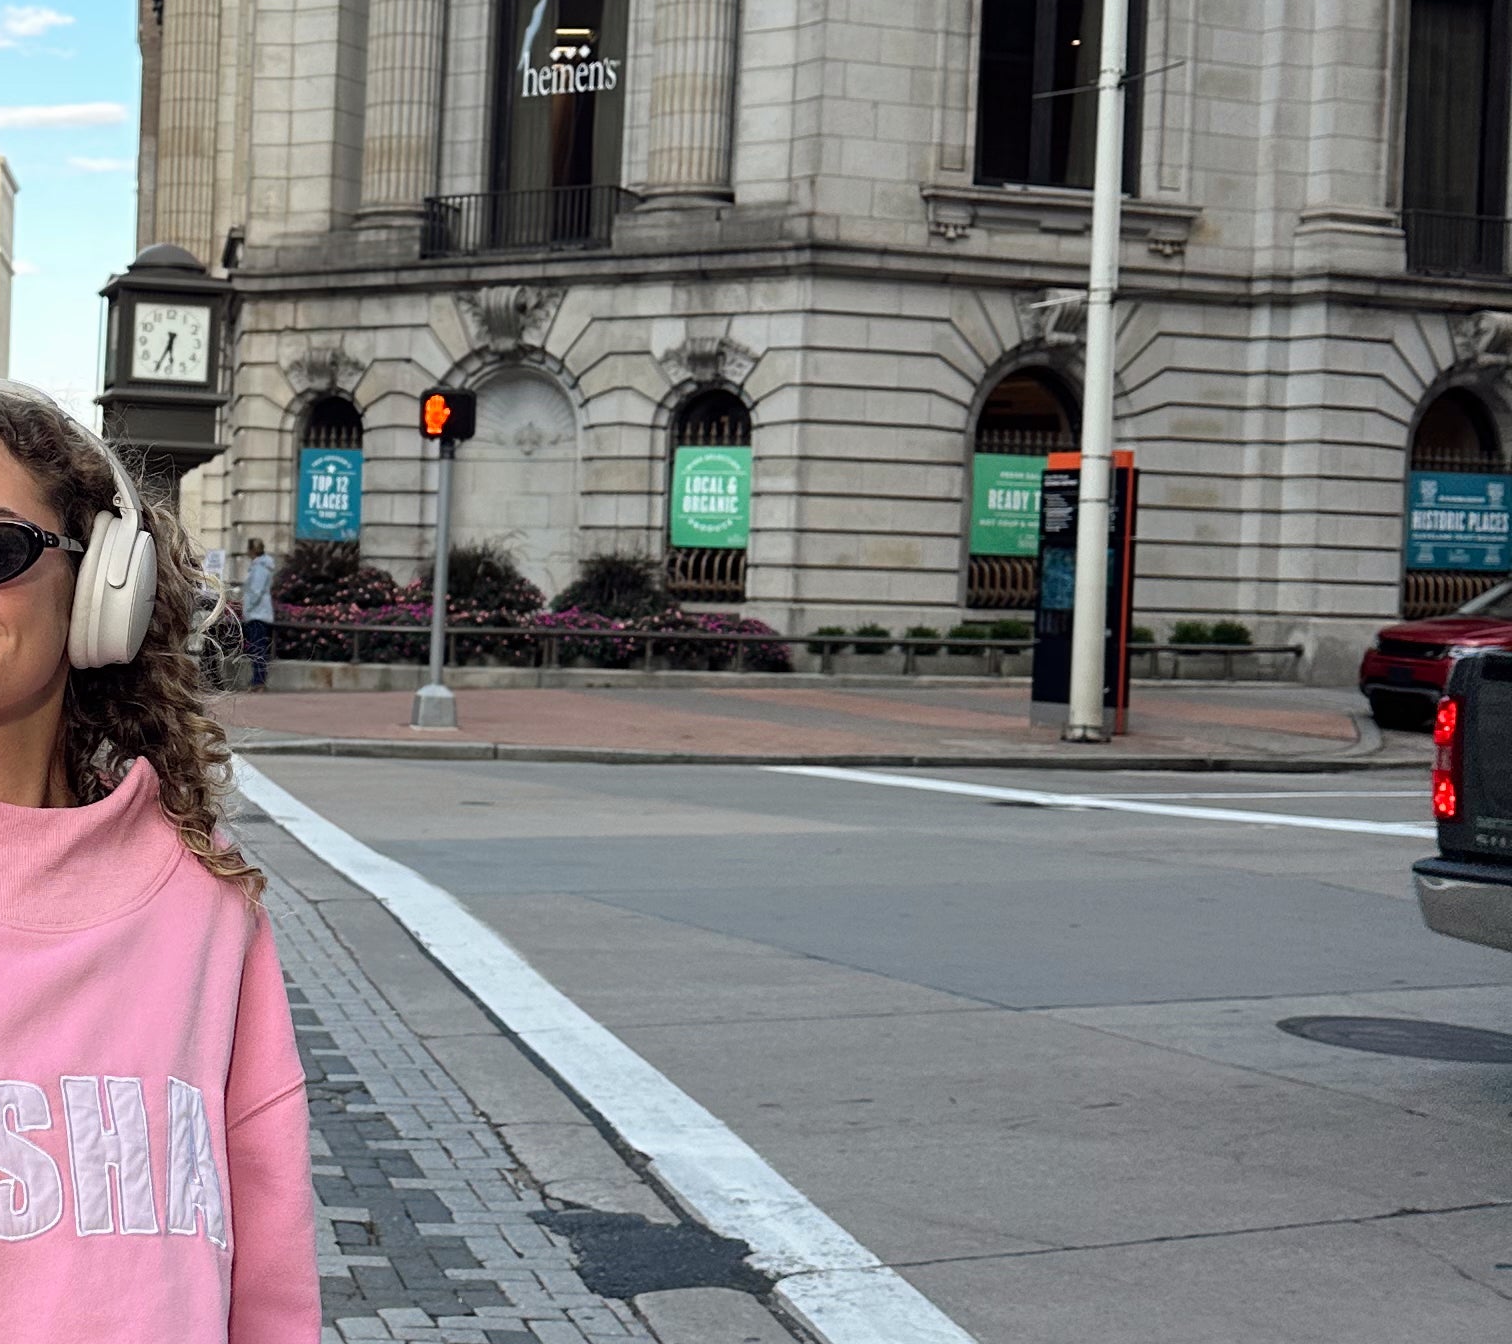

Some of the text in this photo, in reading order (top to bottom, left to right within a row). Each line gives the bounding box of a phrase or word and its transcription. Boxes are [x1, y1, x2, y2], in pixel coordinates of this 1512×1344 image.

[312, 475, 350, 493] TOP 12
[685, 476, 738, 494] LOCAL &
[308, 492, 350, 511] PLACES
[682, 495, 739, 514] ORGANIC
[988, 488, 1029, 511] READY
[1411, 509, 1509, 534] HISTORIC PLACES
